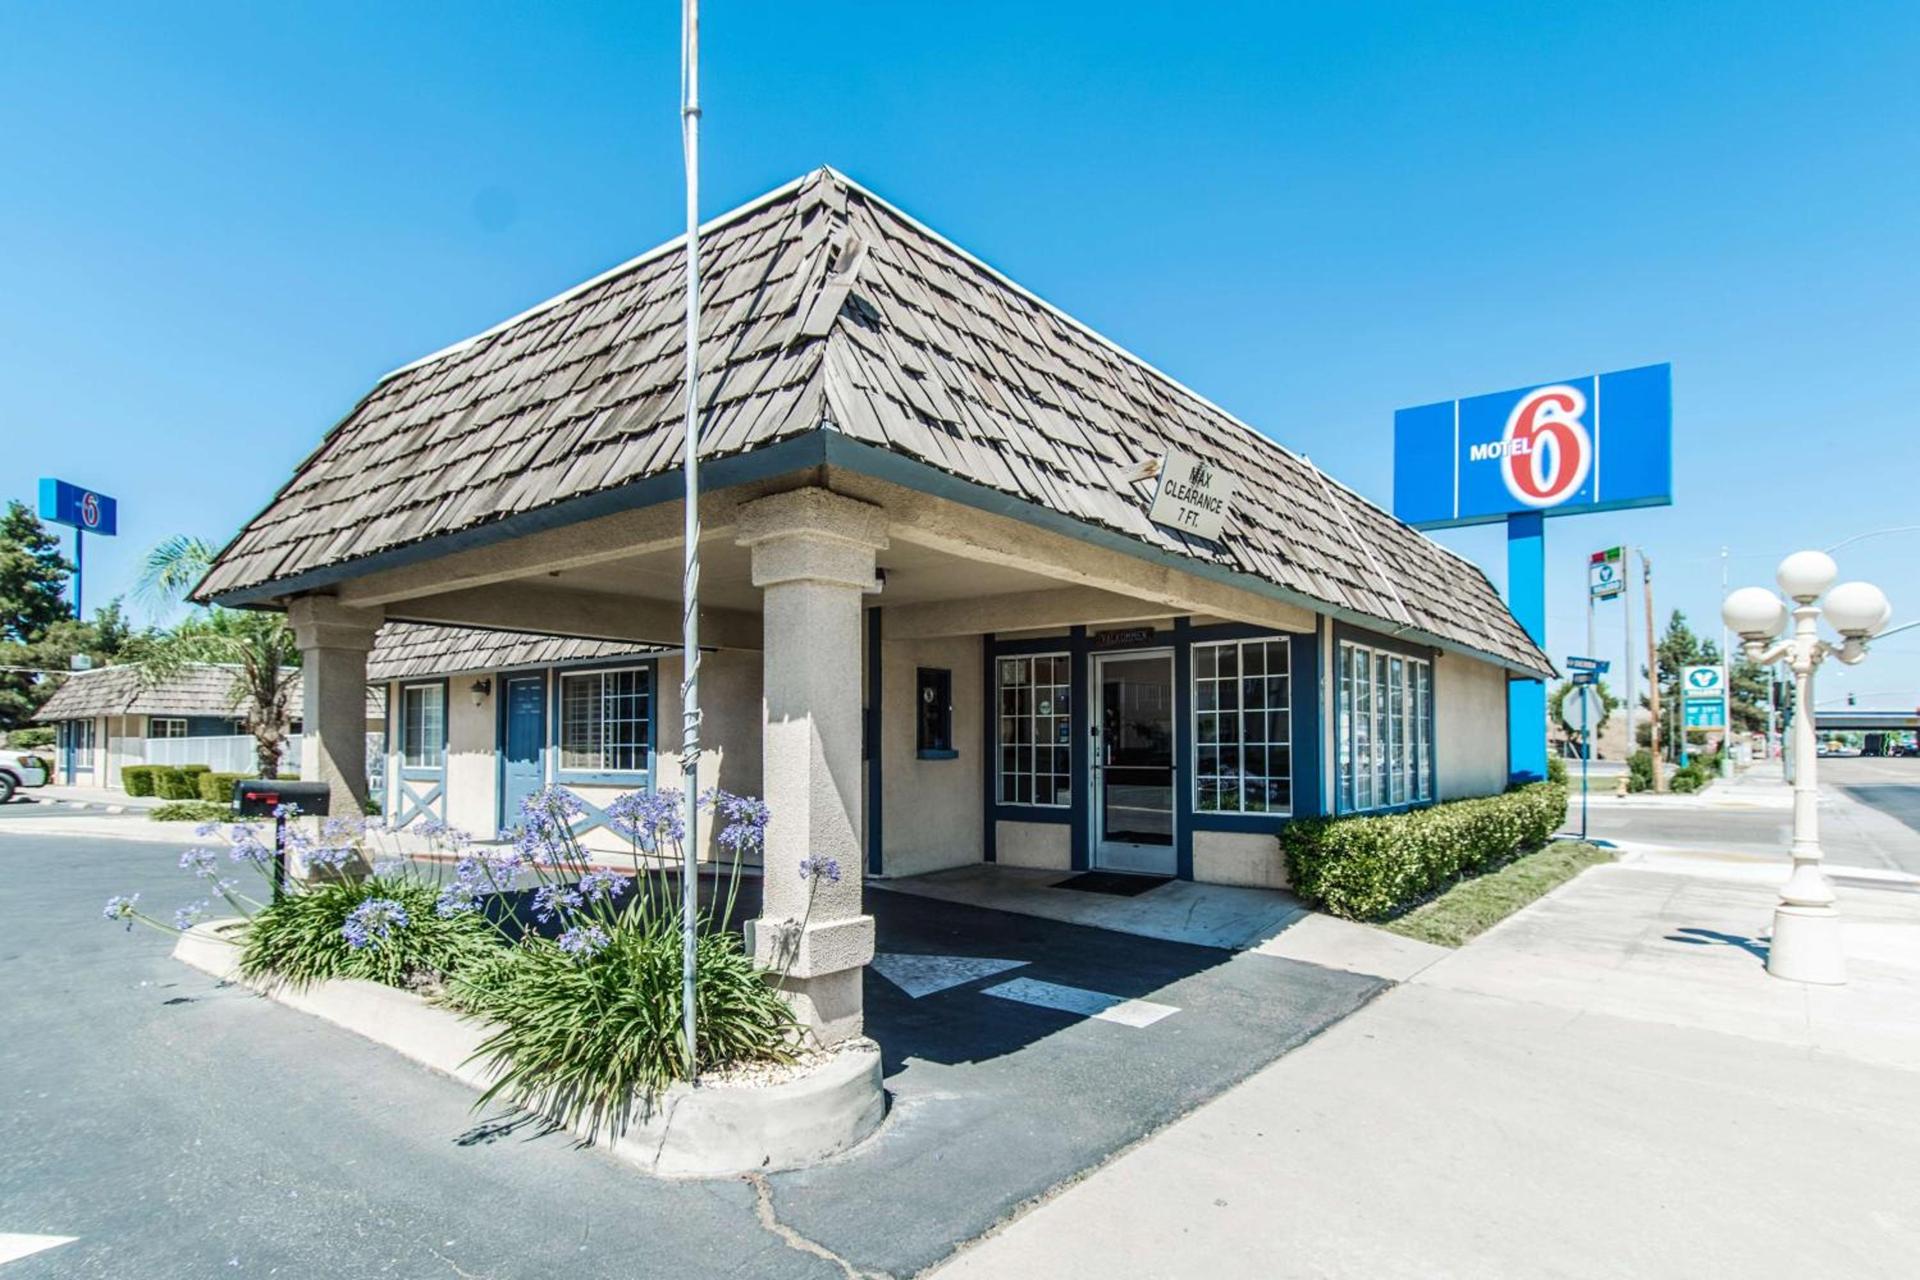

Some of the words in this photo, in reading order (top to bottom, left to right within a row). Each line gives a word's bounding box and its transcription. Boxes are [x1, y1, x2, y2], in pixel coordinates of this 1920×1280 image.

[1470, 437, 1533, 462] MOTEL
[1502, 386, 1589, 505] 6
[1188, 466, 1213, 489] MAX
[82, 492, 99, 527] 6
[1164, 479, 1223, 515] CLEARANCE
[1177, 507, 1184, 522] 7
[1185, 509, 1200, 528] FT.
